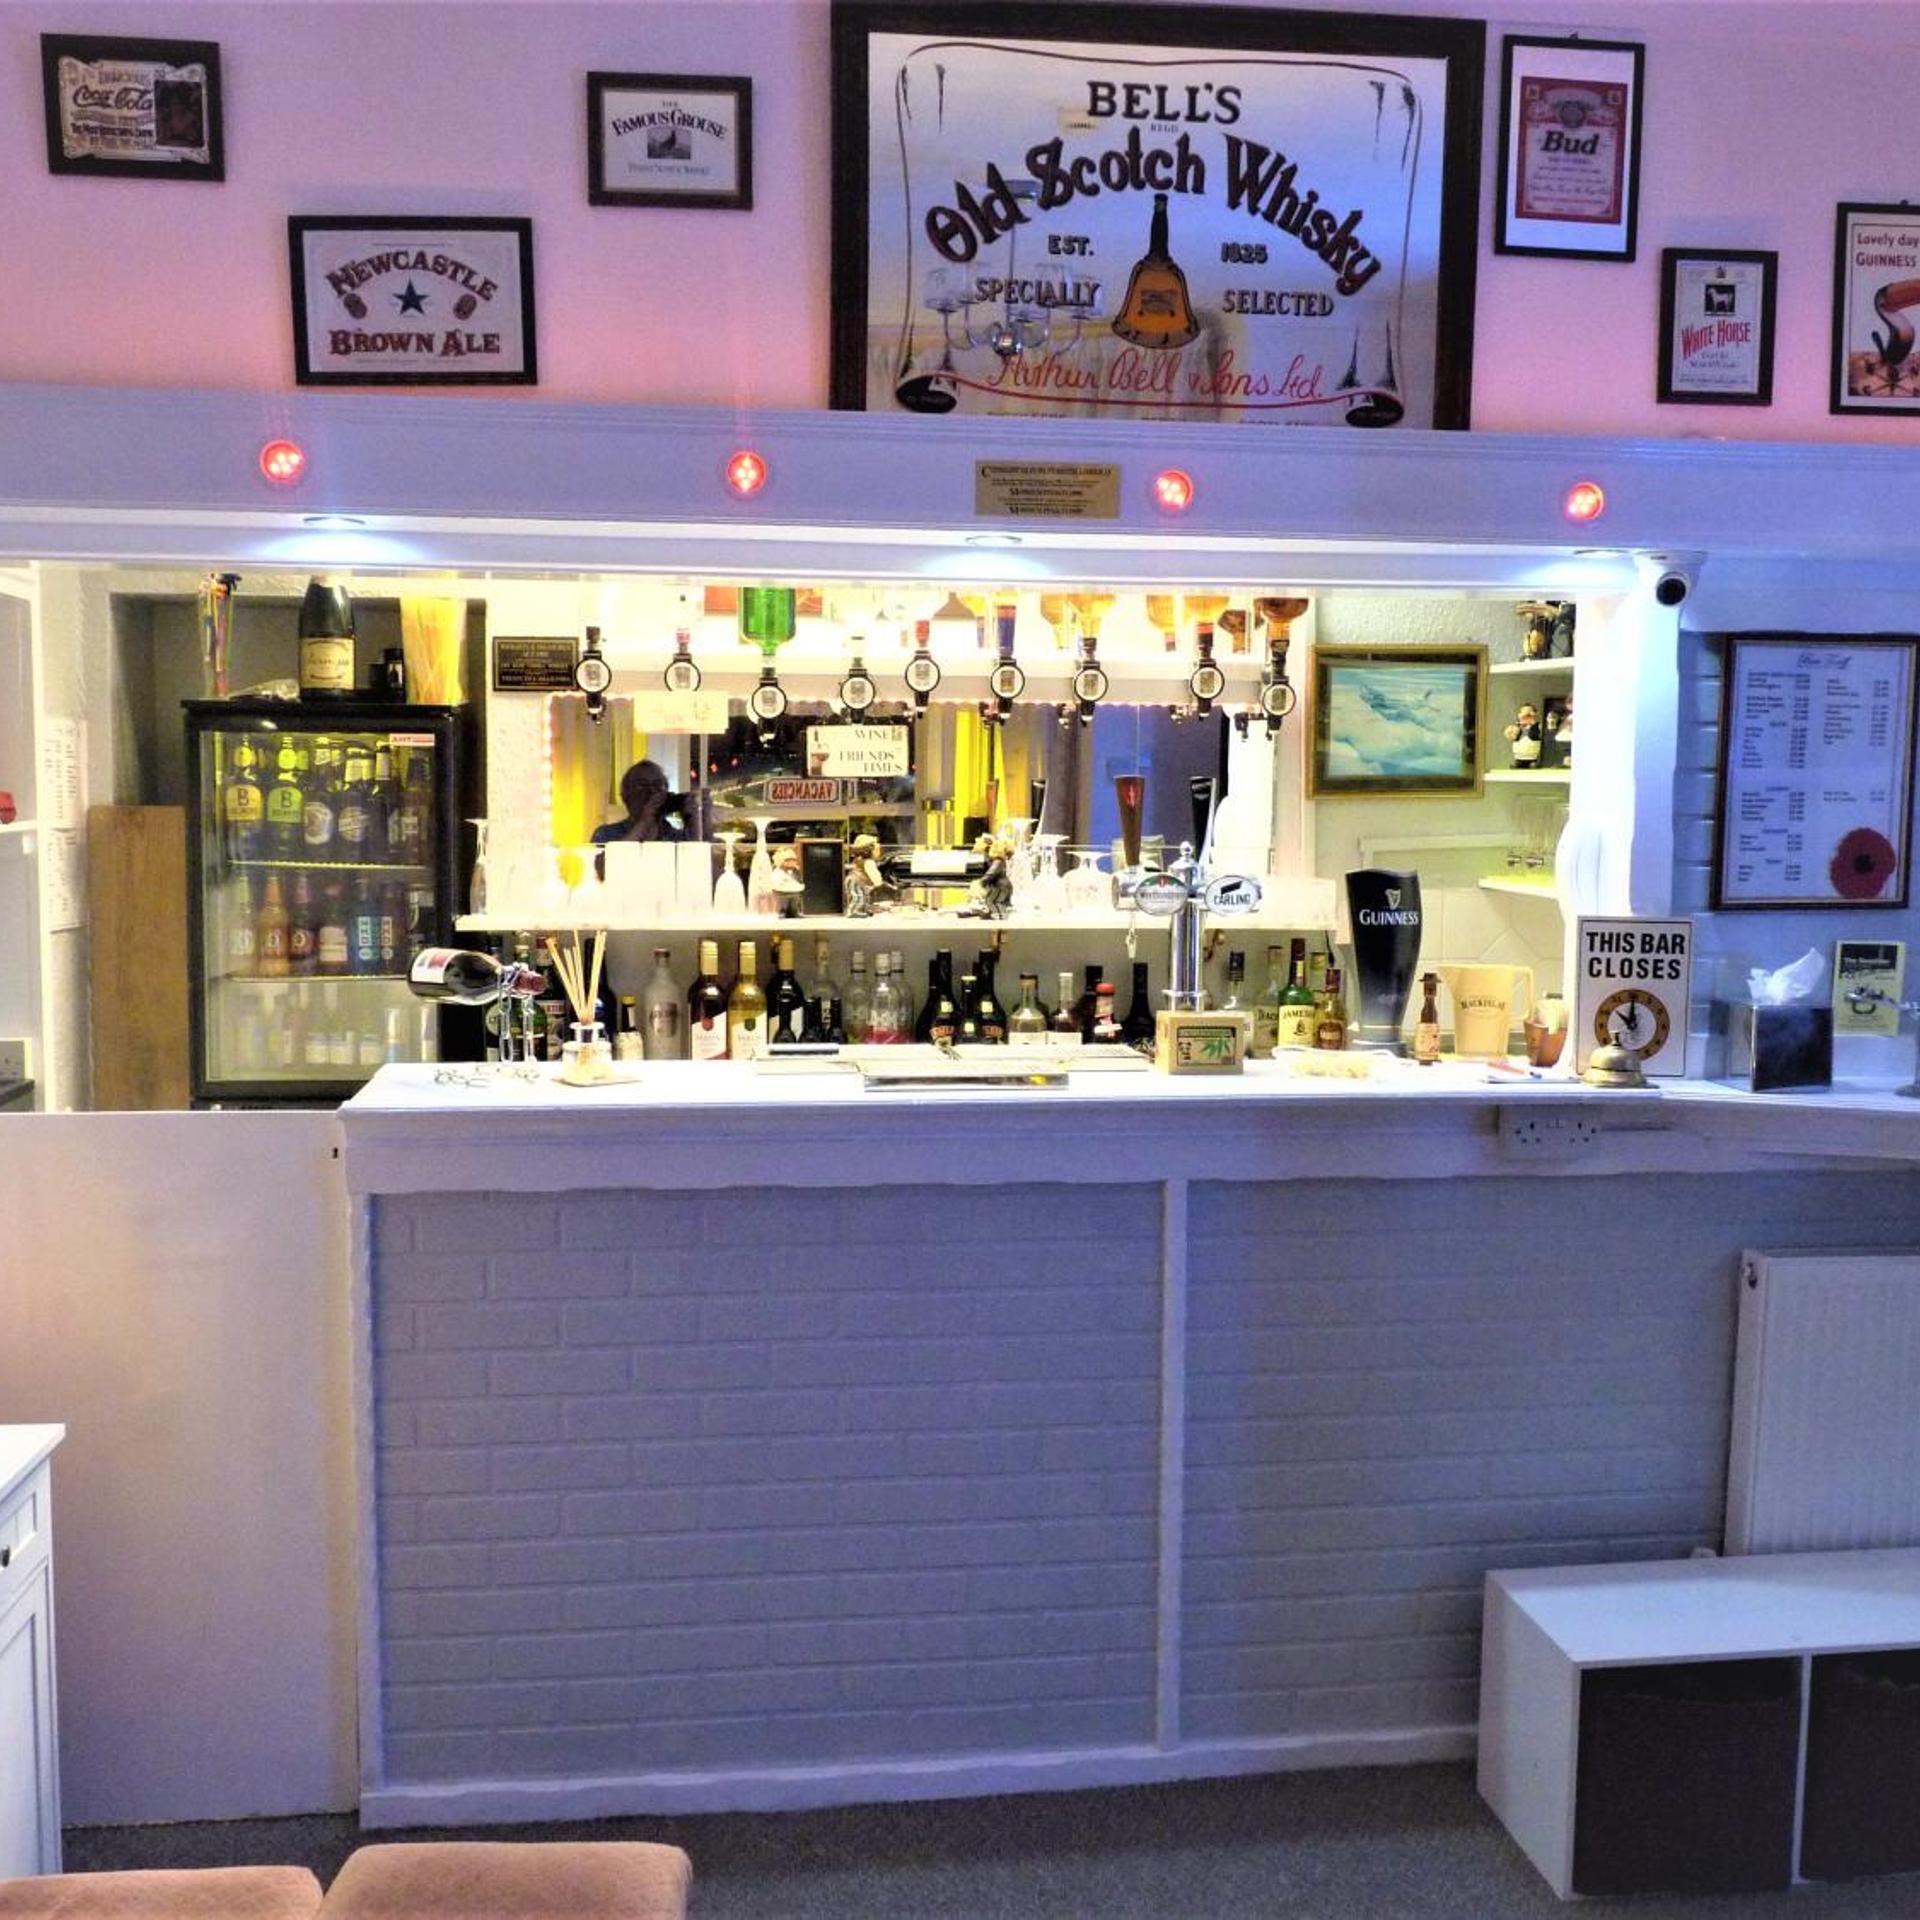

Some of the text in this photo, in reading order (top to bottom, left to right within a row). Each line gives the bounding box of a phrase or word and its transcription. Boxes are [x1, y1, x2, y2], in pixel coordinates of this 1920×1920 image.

[1087, 81, 1242, 125] BELL'S
[611, 109, 728, 140] FAMOUS GROUSE
[1540, 131, 1600, 155] Bud
[925, 125, 1382, 296] Old Scotch Whisky
[1048, 234, 1095, 256] EST.
[1857, 232, 1894, 248] Lovely
[1856, 252, 1917, 268] GUINNESS
[326, 250, 498, 302] NEWCASTLE
[975, 277, 1335, 317] SPECIALLY SELECTED
[328, 328, 501, 357] BROWN ALE
[1682, 320, 1752, 360] WHITE HORSE
[1109, 348, 1184, 394] Bell
[840, 751, 895, 761] FRIENDS
[864, 762, 903, 773] TIMES
[1359, 908, 1419, 926] GUINNESS
[1586, 932, 1685, 955] THIS BAR
[1588, 957, 1681, 980] CLOSES
